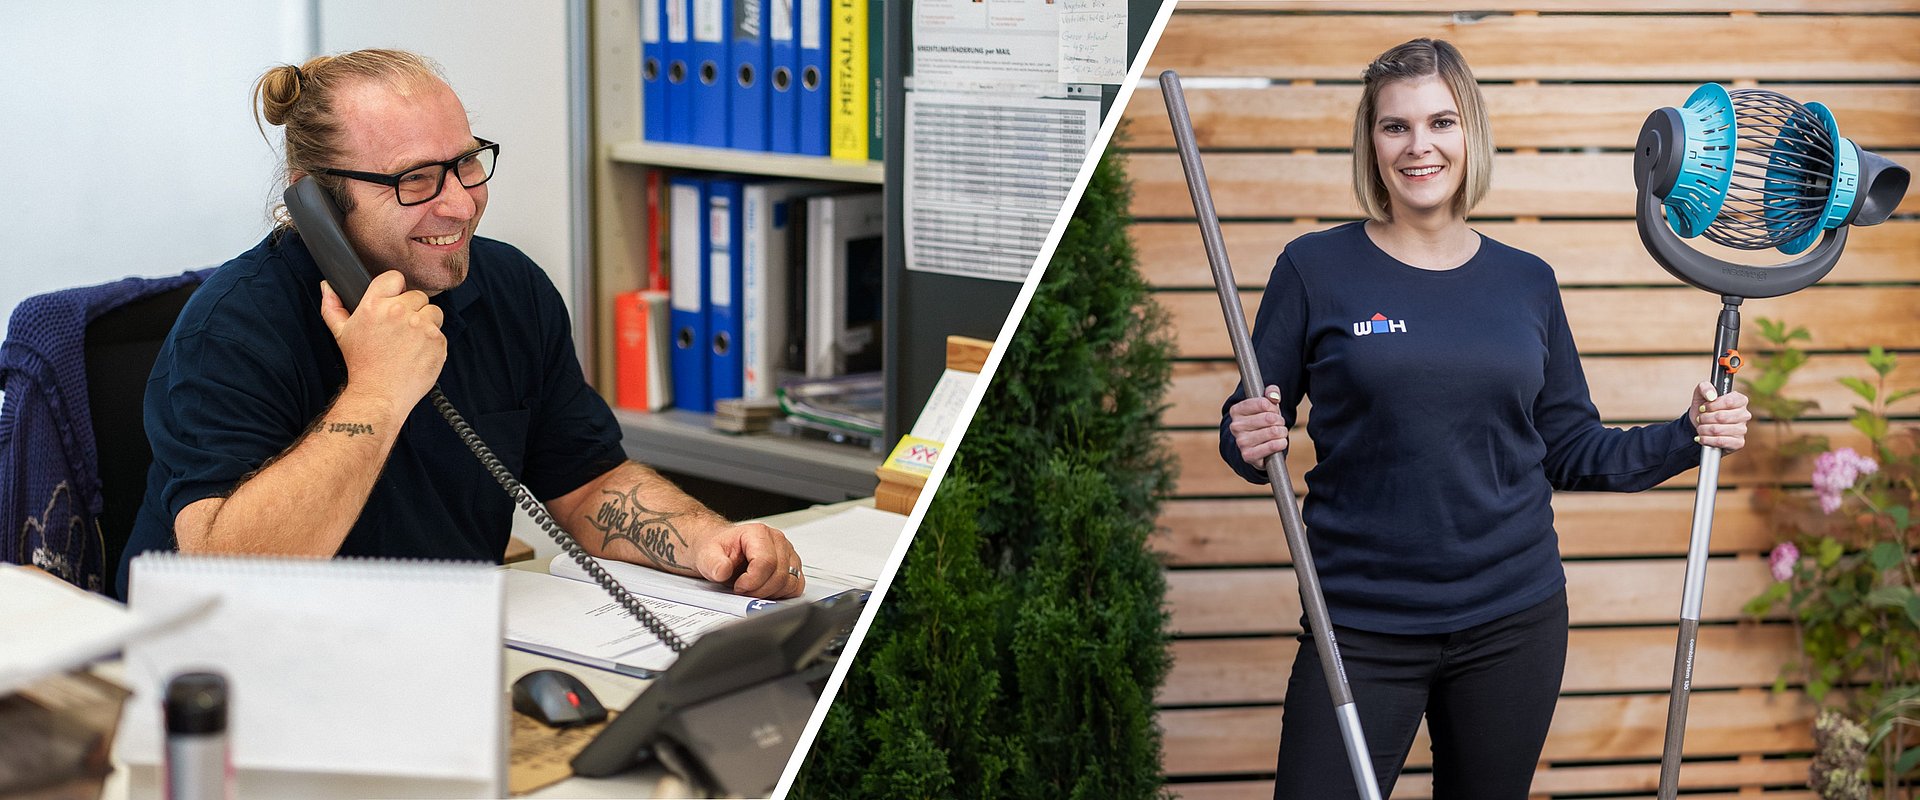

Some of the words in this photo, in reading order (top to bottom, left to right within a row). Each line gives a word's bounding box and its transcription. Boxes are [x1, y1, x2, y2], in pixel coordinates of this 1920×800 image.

[841, 31, 853, 115] METALL
[597, 498, 631, 533] viva
[645, 526, 677, 565] vida
[1685, 638, 1695, 679] combisystem
